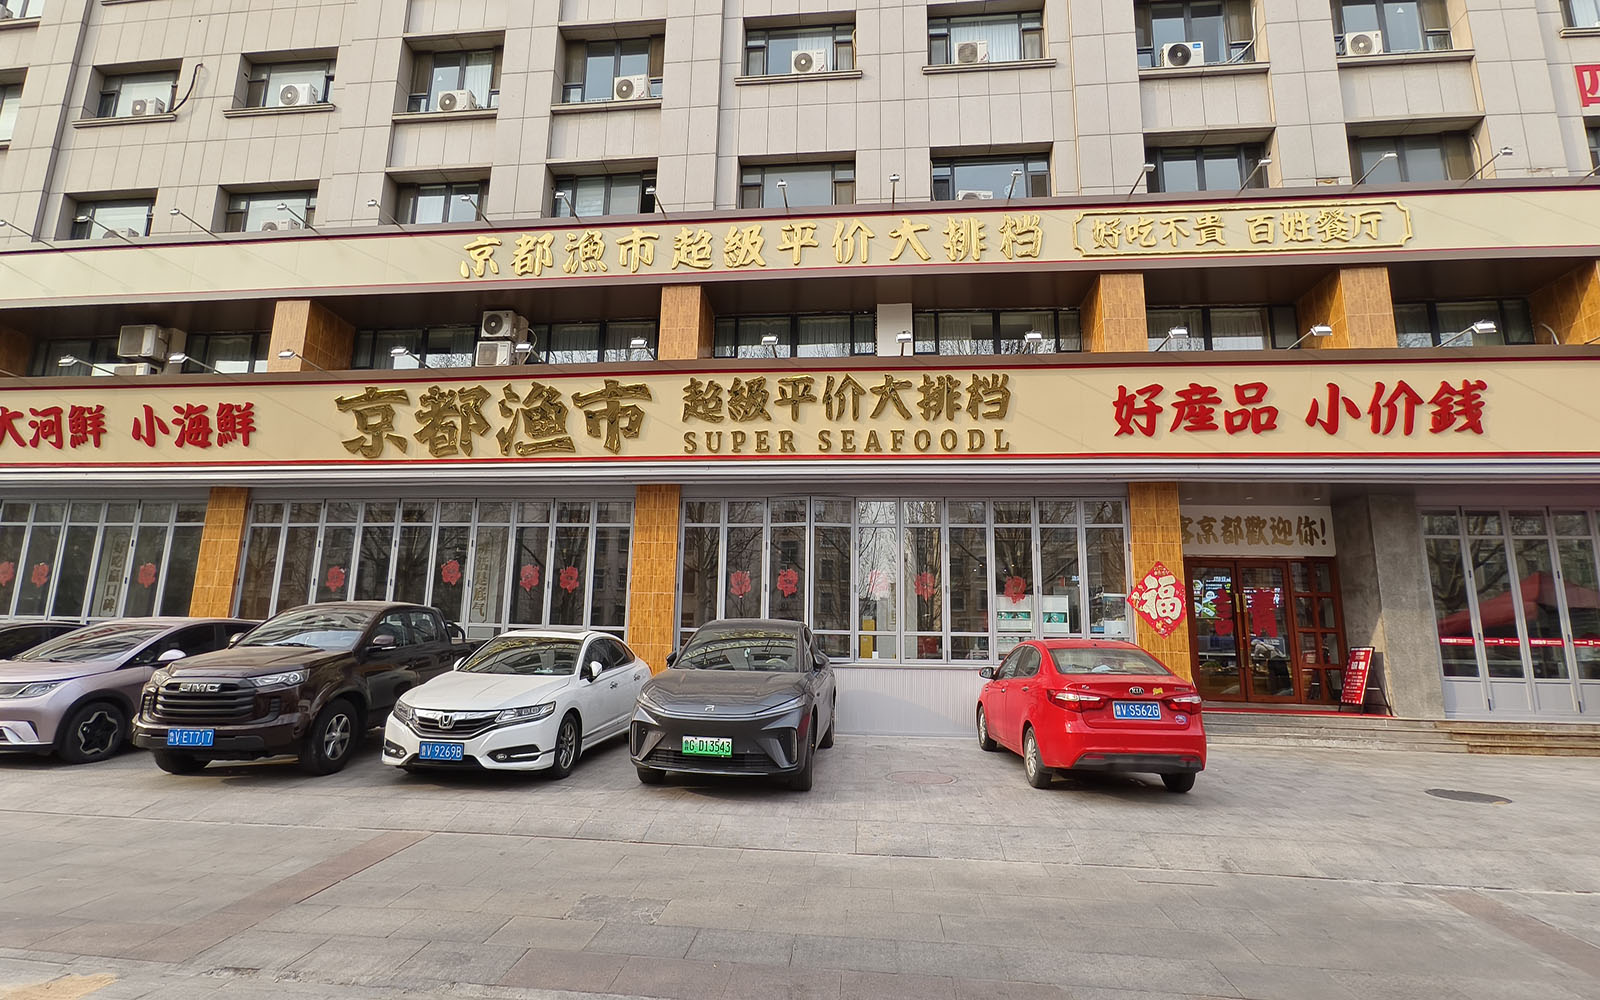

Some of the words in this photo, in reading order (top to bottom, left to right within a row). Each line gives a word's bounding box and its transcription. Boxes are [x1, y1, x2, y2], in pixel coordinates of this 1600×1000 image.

[1092, 213, 1226, 249] 好吃不貴
[1245, 207, 1382, 244] 百姓餐厅
[132, 402, 256, 449] 小海鮮
[683, 429, 796, 453] SUPER
[818, 428, 1010, 452] SEAFOODL
[1142, 575, 1182, 620] 福
